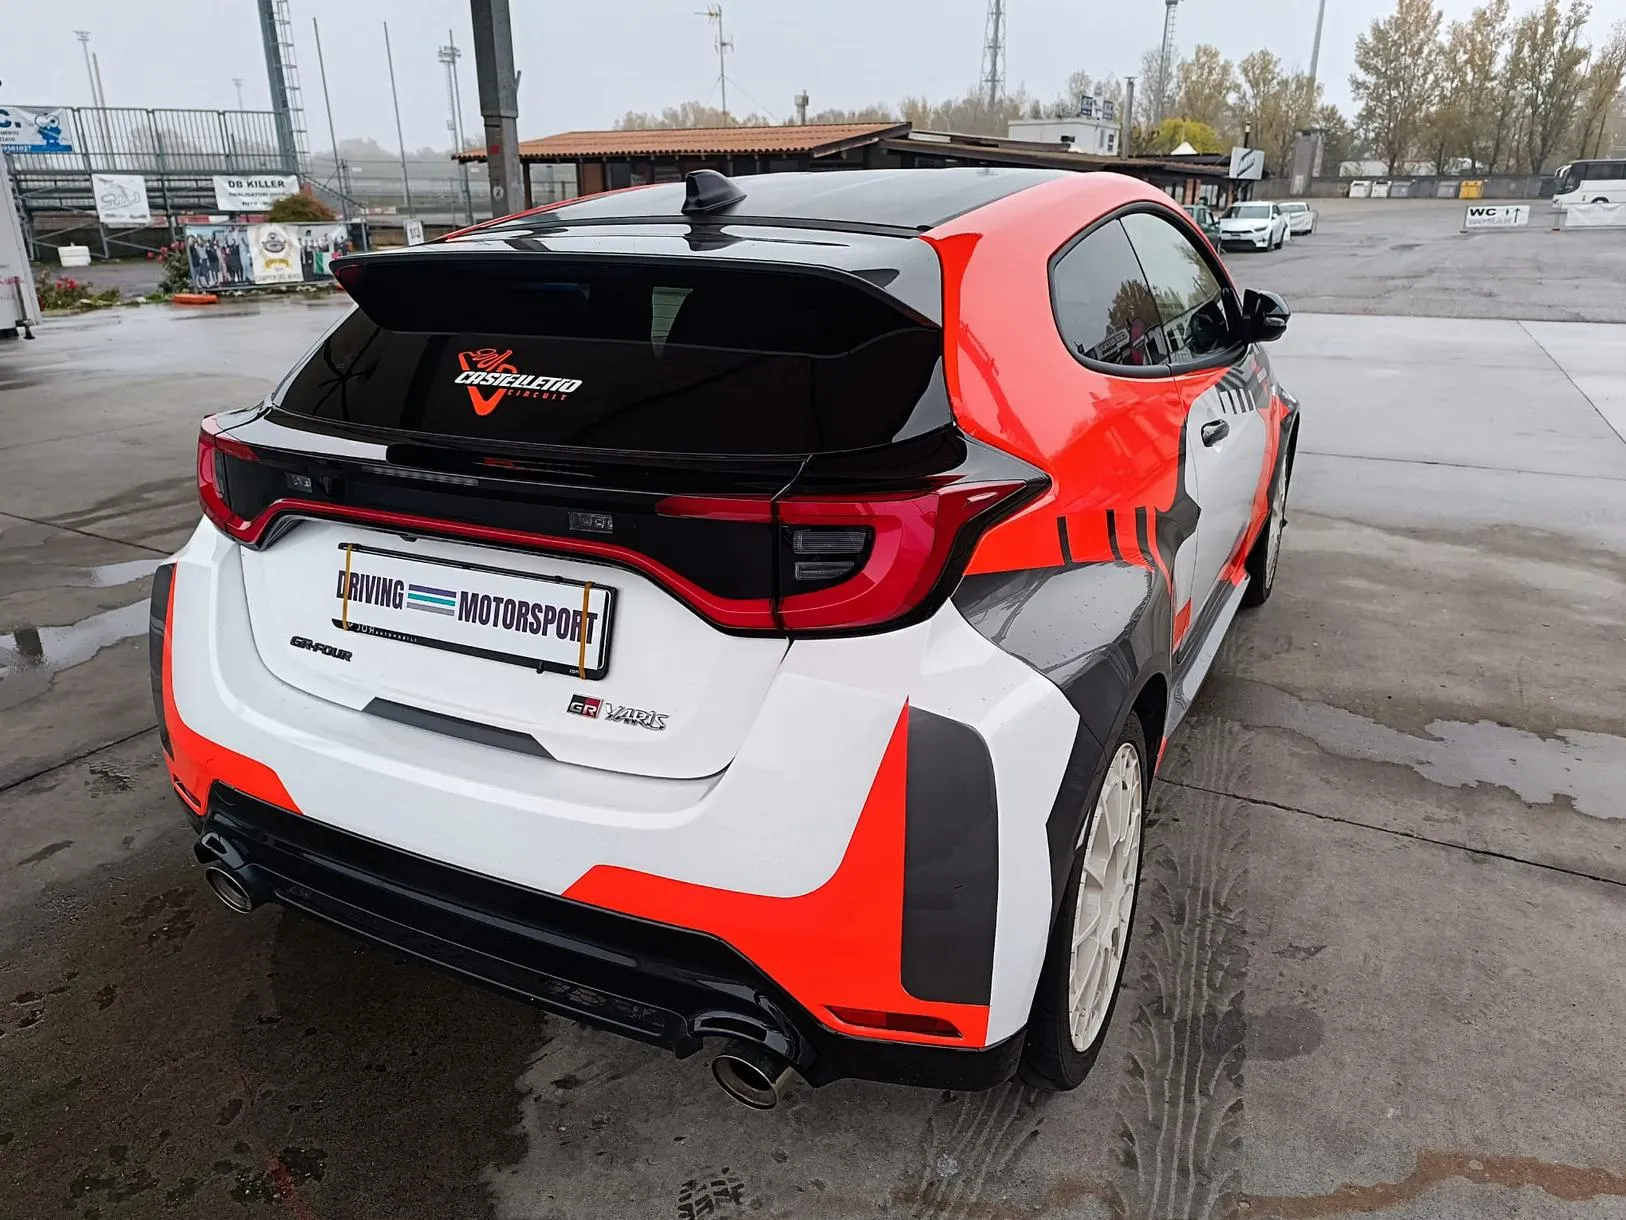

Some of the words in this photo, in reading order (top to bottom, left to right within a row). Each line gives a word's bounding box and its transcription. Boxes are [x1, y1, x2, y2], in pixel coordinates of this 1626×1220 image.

[228, 180, 243, 188] DB
[247, 180, 285, 188] KILLER
[1469, 208, 1496, 216] WC
[454, 371, 583, 393] CASTELLETTO
[507, 389, 567, 401] CIRCUIT
[336, 570, 405, 610] DRIVING
[458, 591, 598, 645] MOTORSPORT
[569, 702, 598, 717] GR
[605, 703, 670, 730] YARIS
